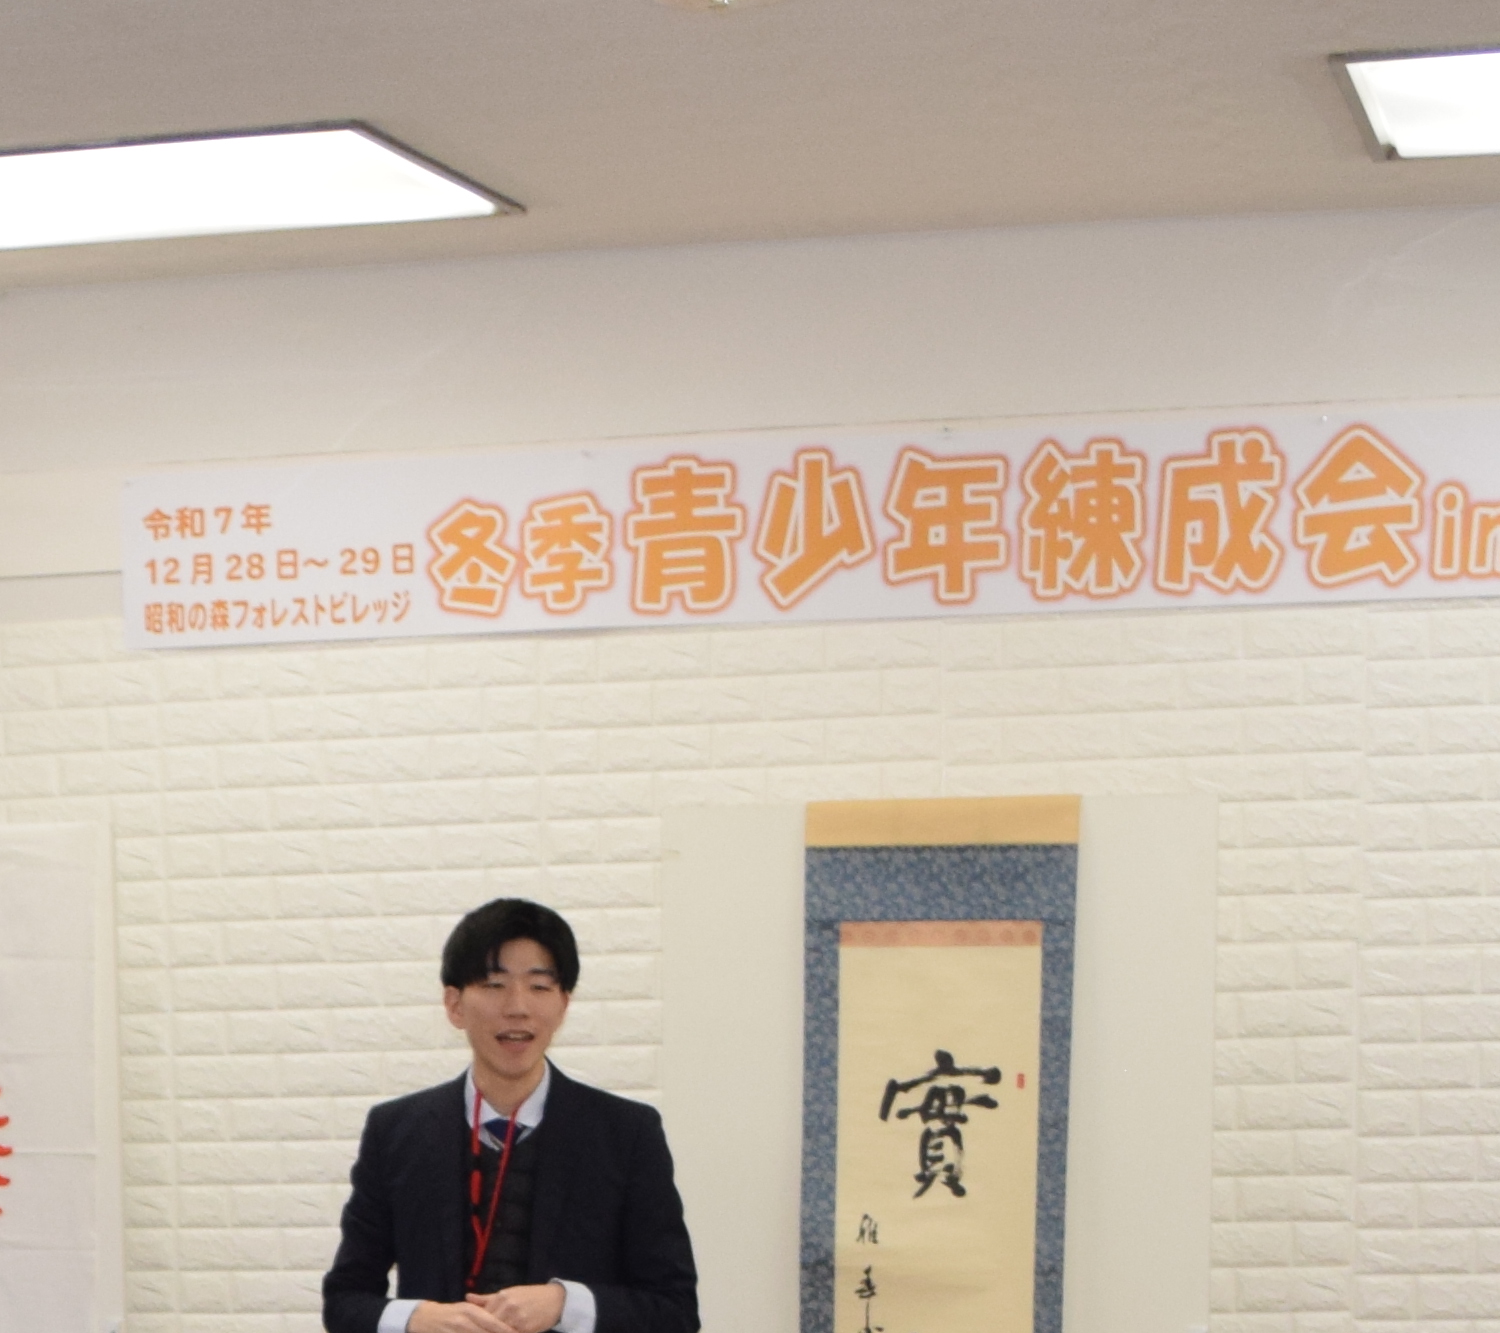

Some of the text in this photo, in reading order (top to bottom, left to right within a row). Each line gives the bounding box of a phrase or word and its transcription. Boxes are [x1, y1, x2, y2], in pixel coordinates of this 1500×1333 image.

[144, 592, 411, 633] 昭和の森フォレストビレッジ
